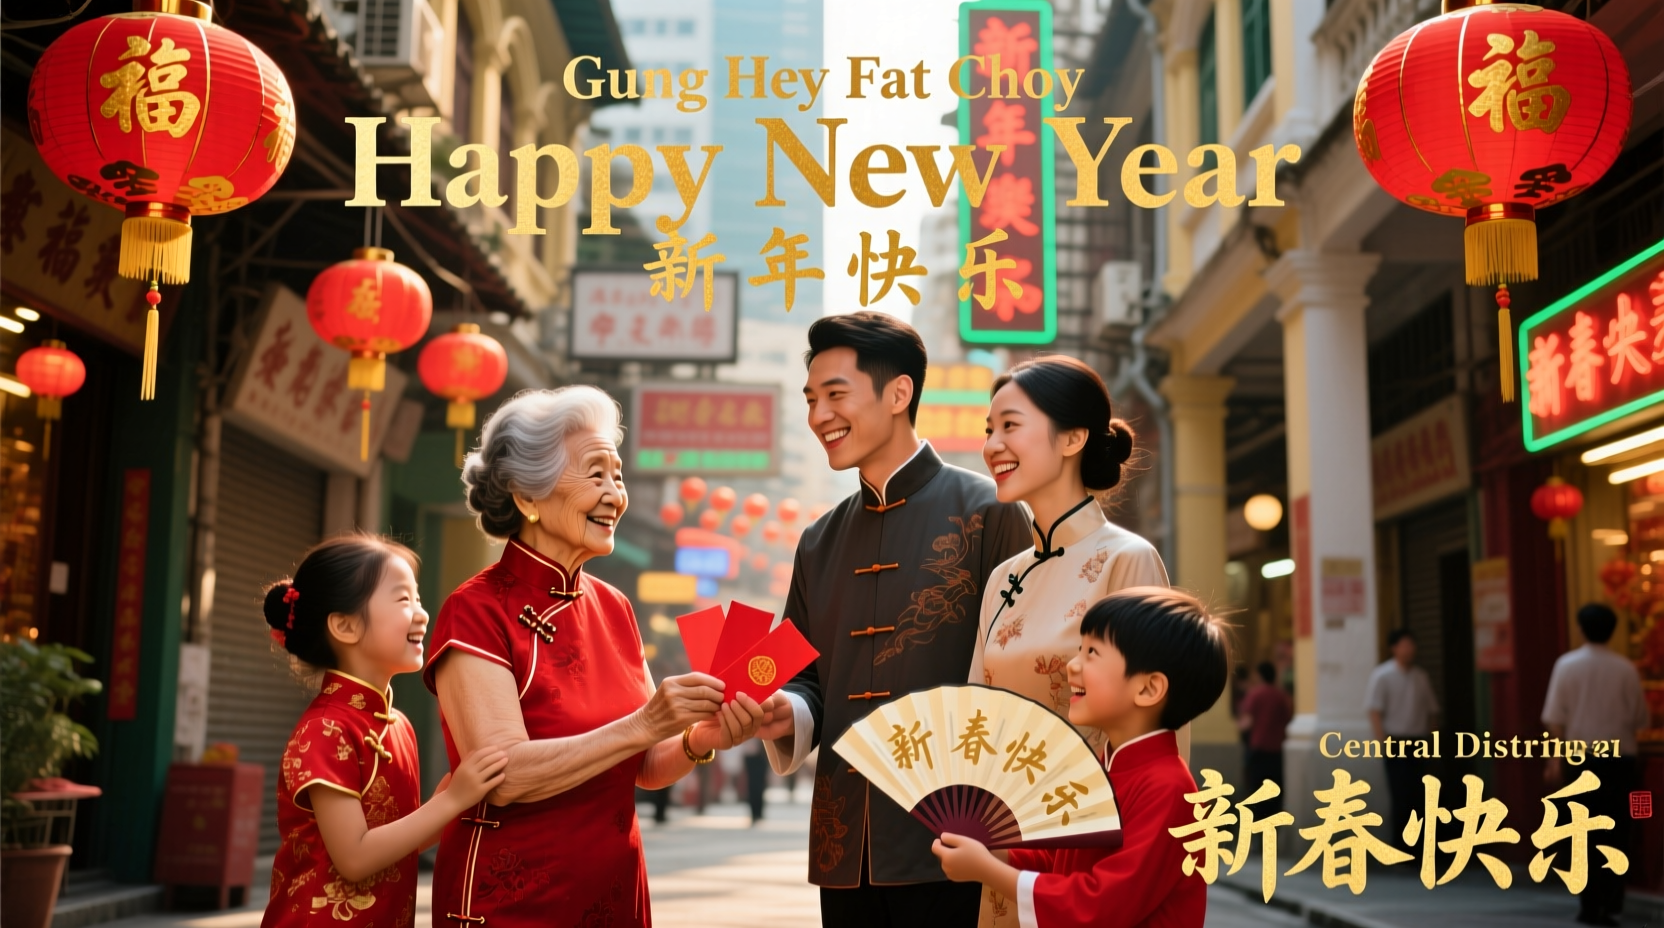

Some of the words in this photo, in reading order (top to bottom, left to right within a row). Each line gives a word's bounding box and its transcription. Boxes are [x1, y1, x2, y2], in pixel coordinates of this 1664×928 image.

[100, 35, 201, 138] 福
[1467, 29, 1572, 134] 福
[886, 708, 1090, 826] 新春快乐
